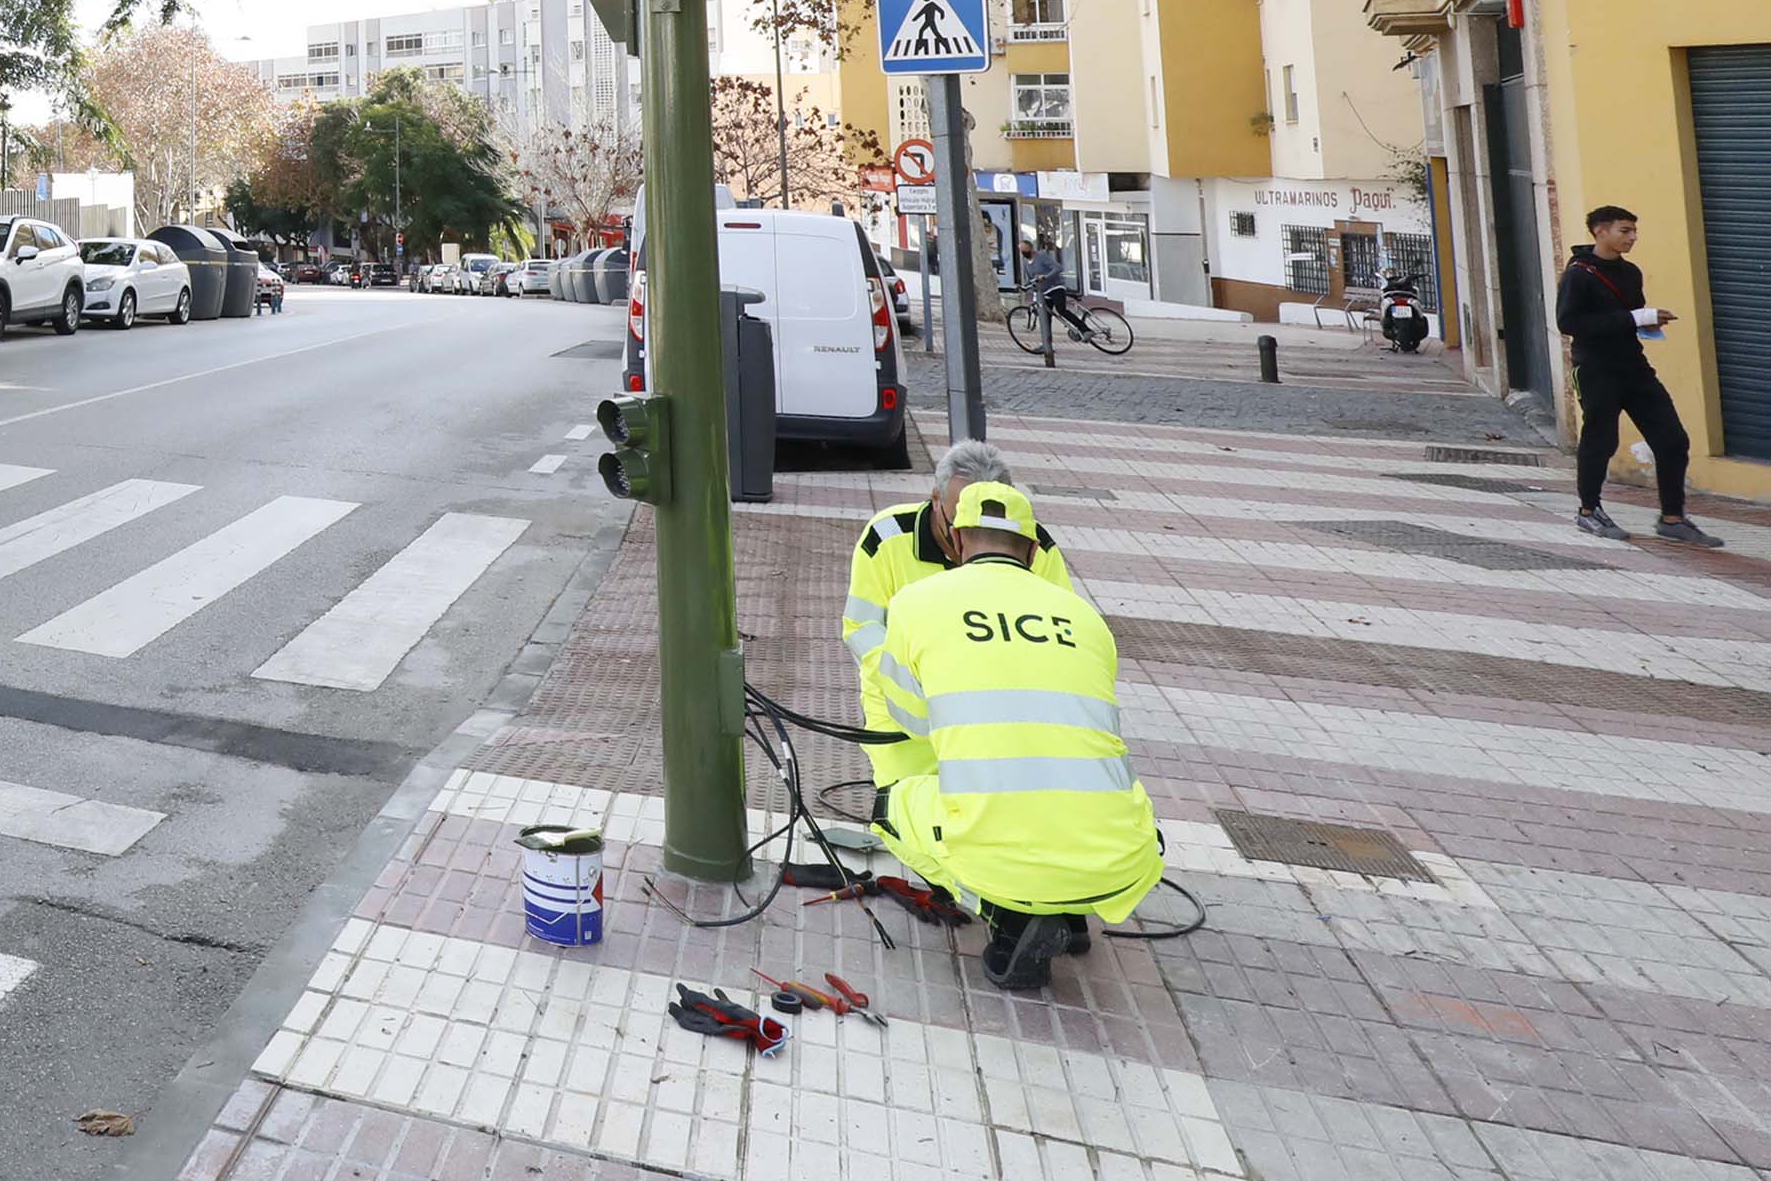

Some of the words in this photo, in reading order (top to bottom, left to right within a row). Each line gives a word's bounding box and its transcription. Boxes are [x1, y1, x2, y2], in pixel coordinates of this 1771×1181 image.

[1254, 190, 1338, 208] ULTRAMARINOS
[813, 345, 861, 353] RENAULT
[963, 610, 1076, 648] SICE
